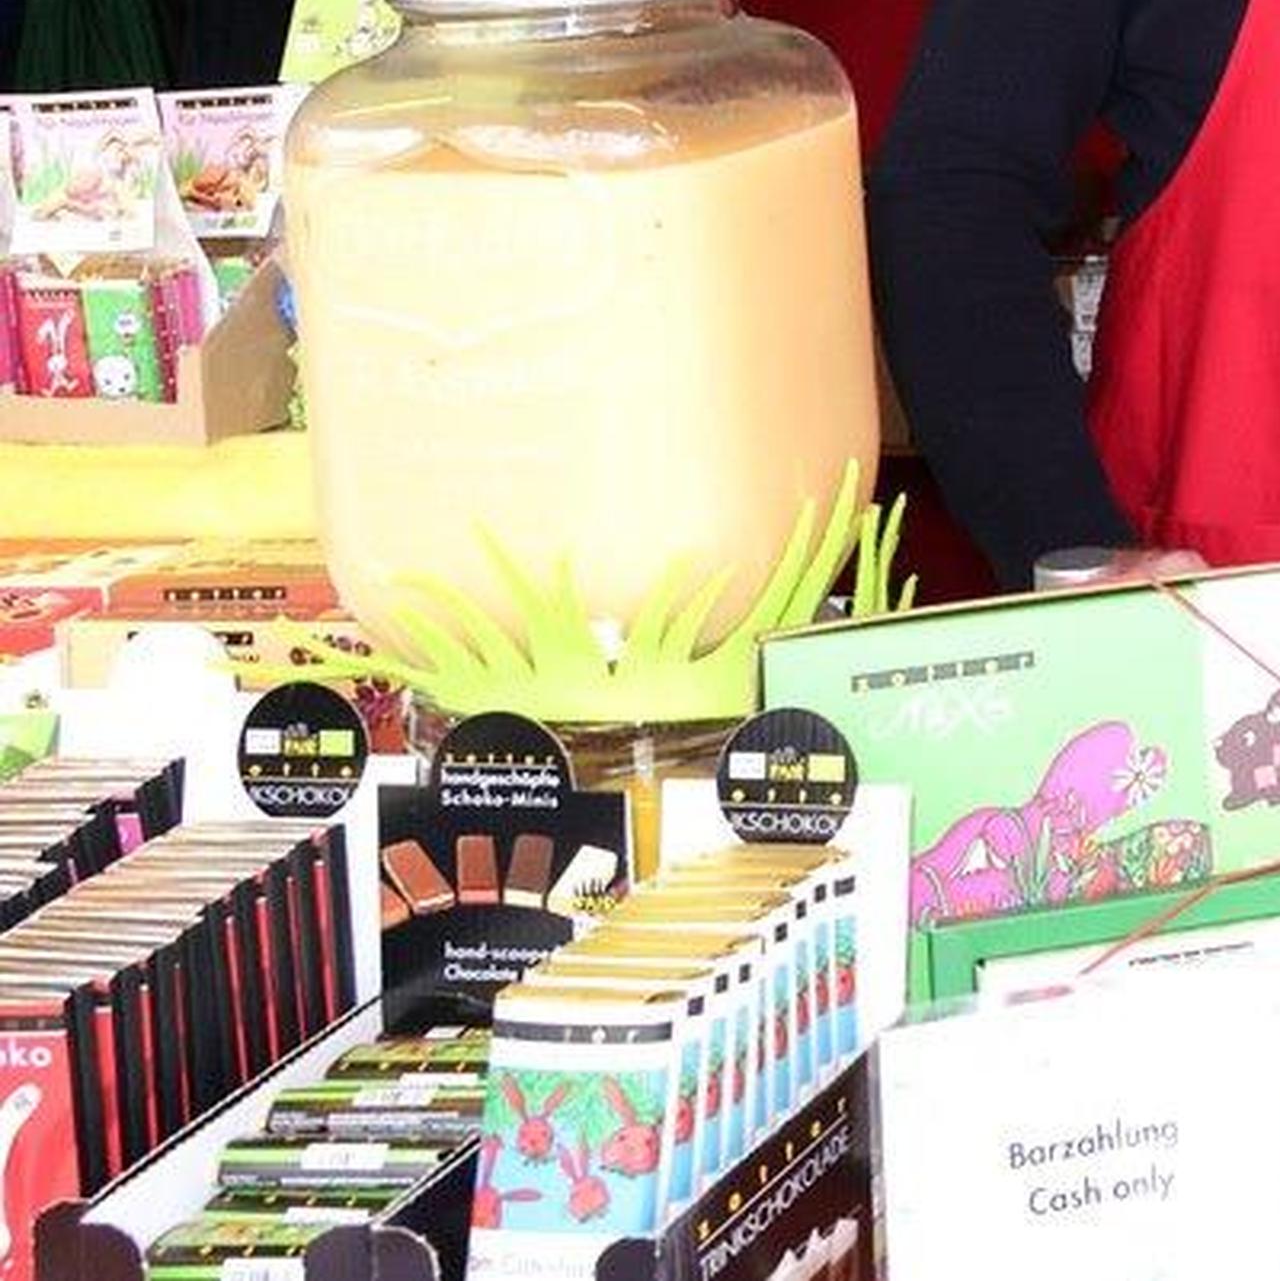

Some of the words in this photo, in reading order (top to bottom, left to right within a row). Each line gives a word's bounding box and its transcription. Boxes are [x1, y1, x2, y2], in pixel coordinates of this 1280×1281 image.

[441, 788, 559, 808] Schoko-Minis
[1009, 1117, 1179, 1170] Barzahlung
[1029, 1175, 1102, 1216] Cash
[1112, 1162, 1175, 1202] only
